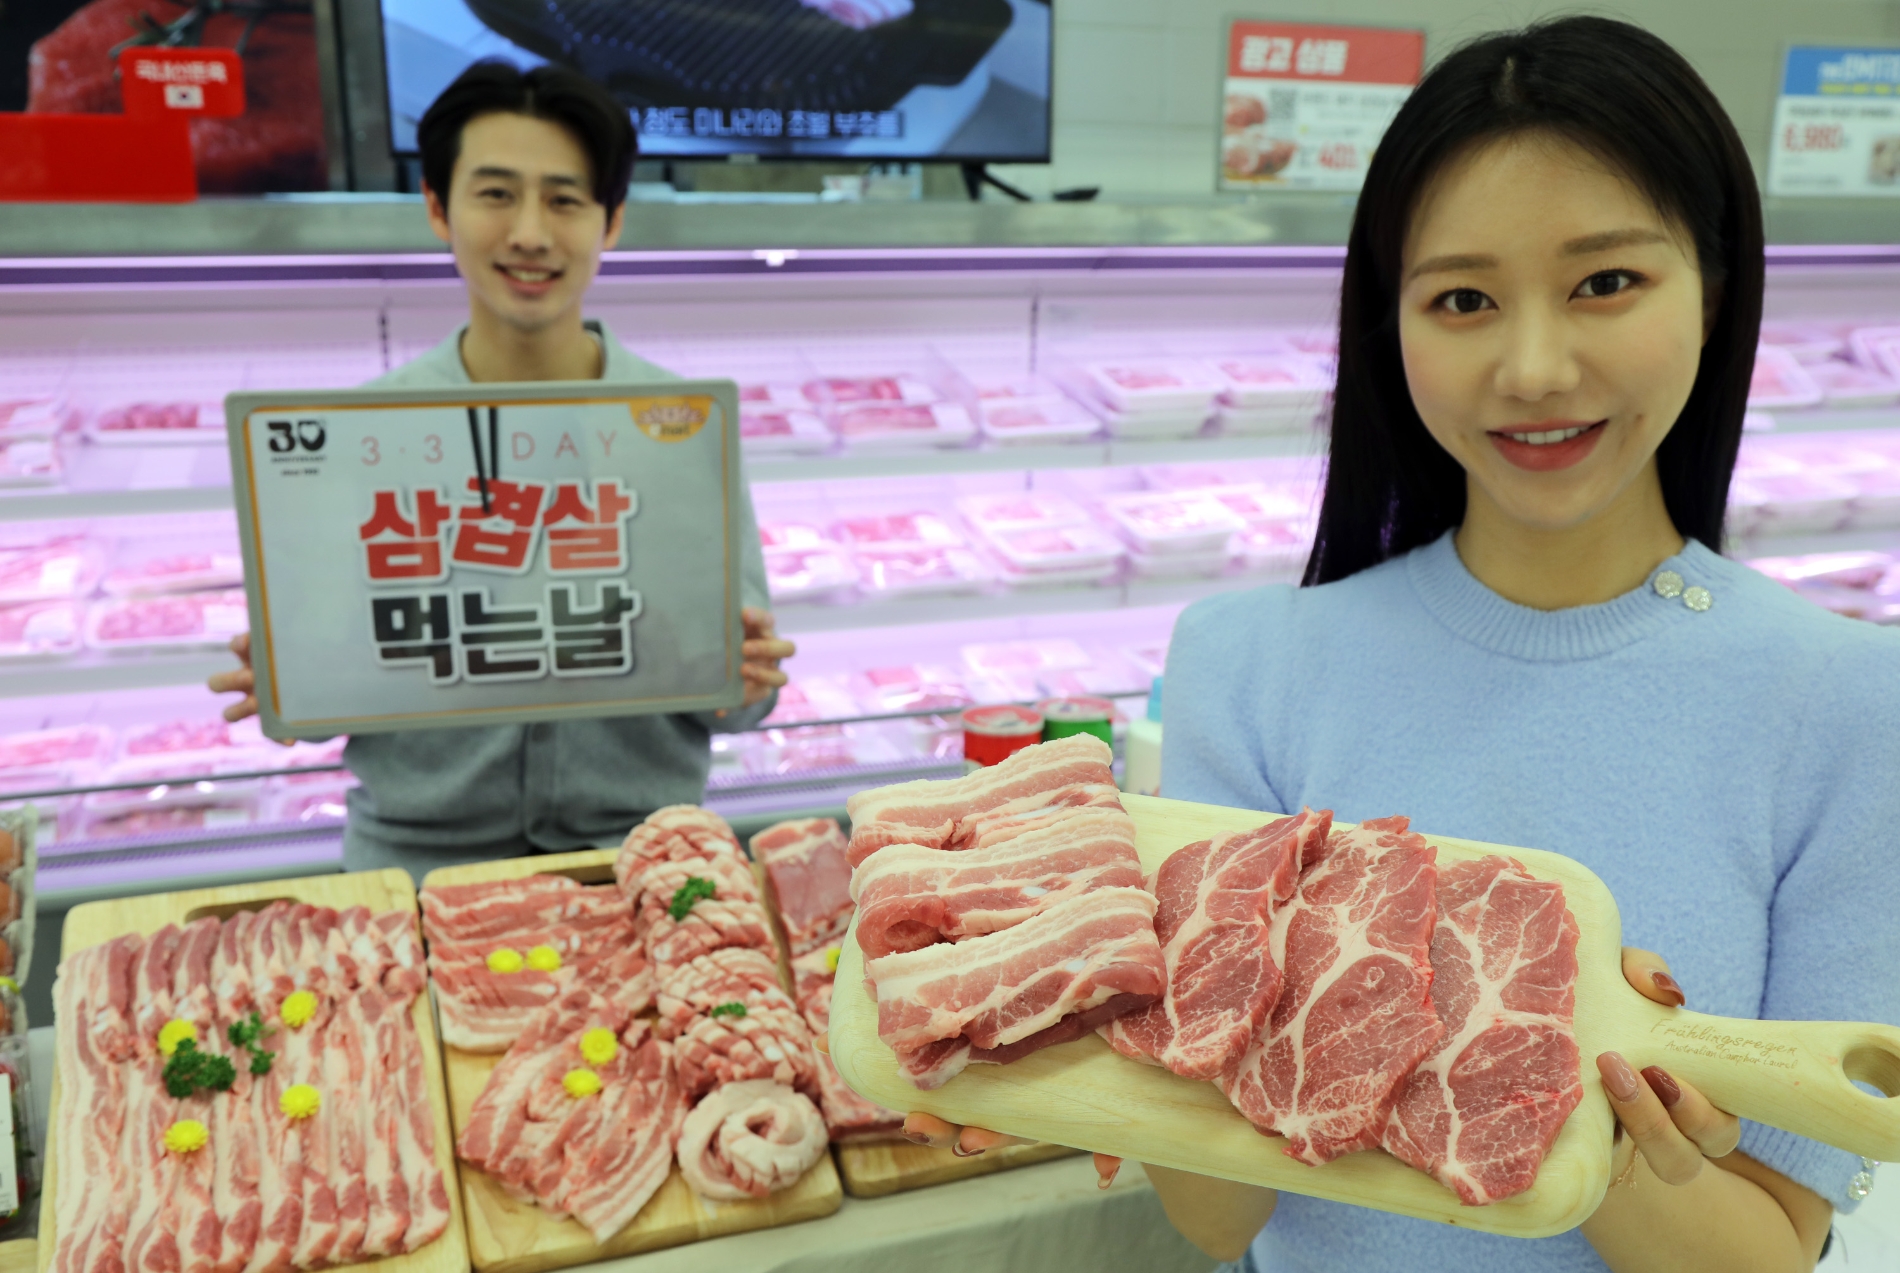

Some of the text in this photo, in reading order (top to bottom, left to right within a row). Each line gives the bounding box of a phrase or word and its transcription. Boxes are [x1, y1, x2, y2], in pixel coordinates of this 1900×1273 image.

[1240, 35, 1349, 76] 광고 상품
[694, 107, 783, 137] 미나리와
[510, 430, 618, 462] DAY
[358, 475, 632, 580] 삼겹살
[370, 584, 635, 679] 먹는날
[1650, 1018, 1798, 1056] Frühlingsregen
[1665, 1040, 1717, 1059] Australian
[1718, 1048, 1761, 1066] Camphor
